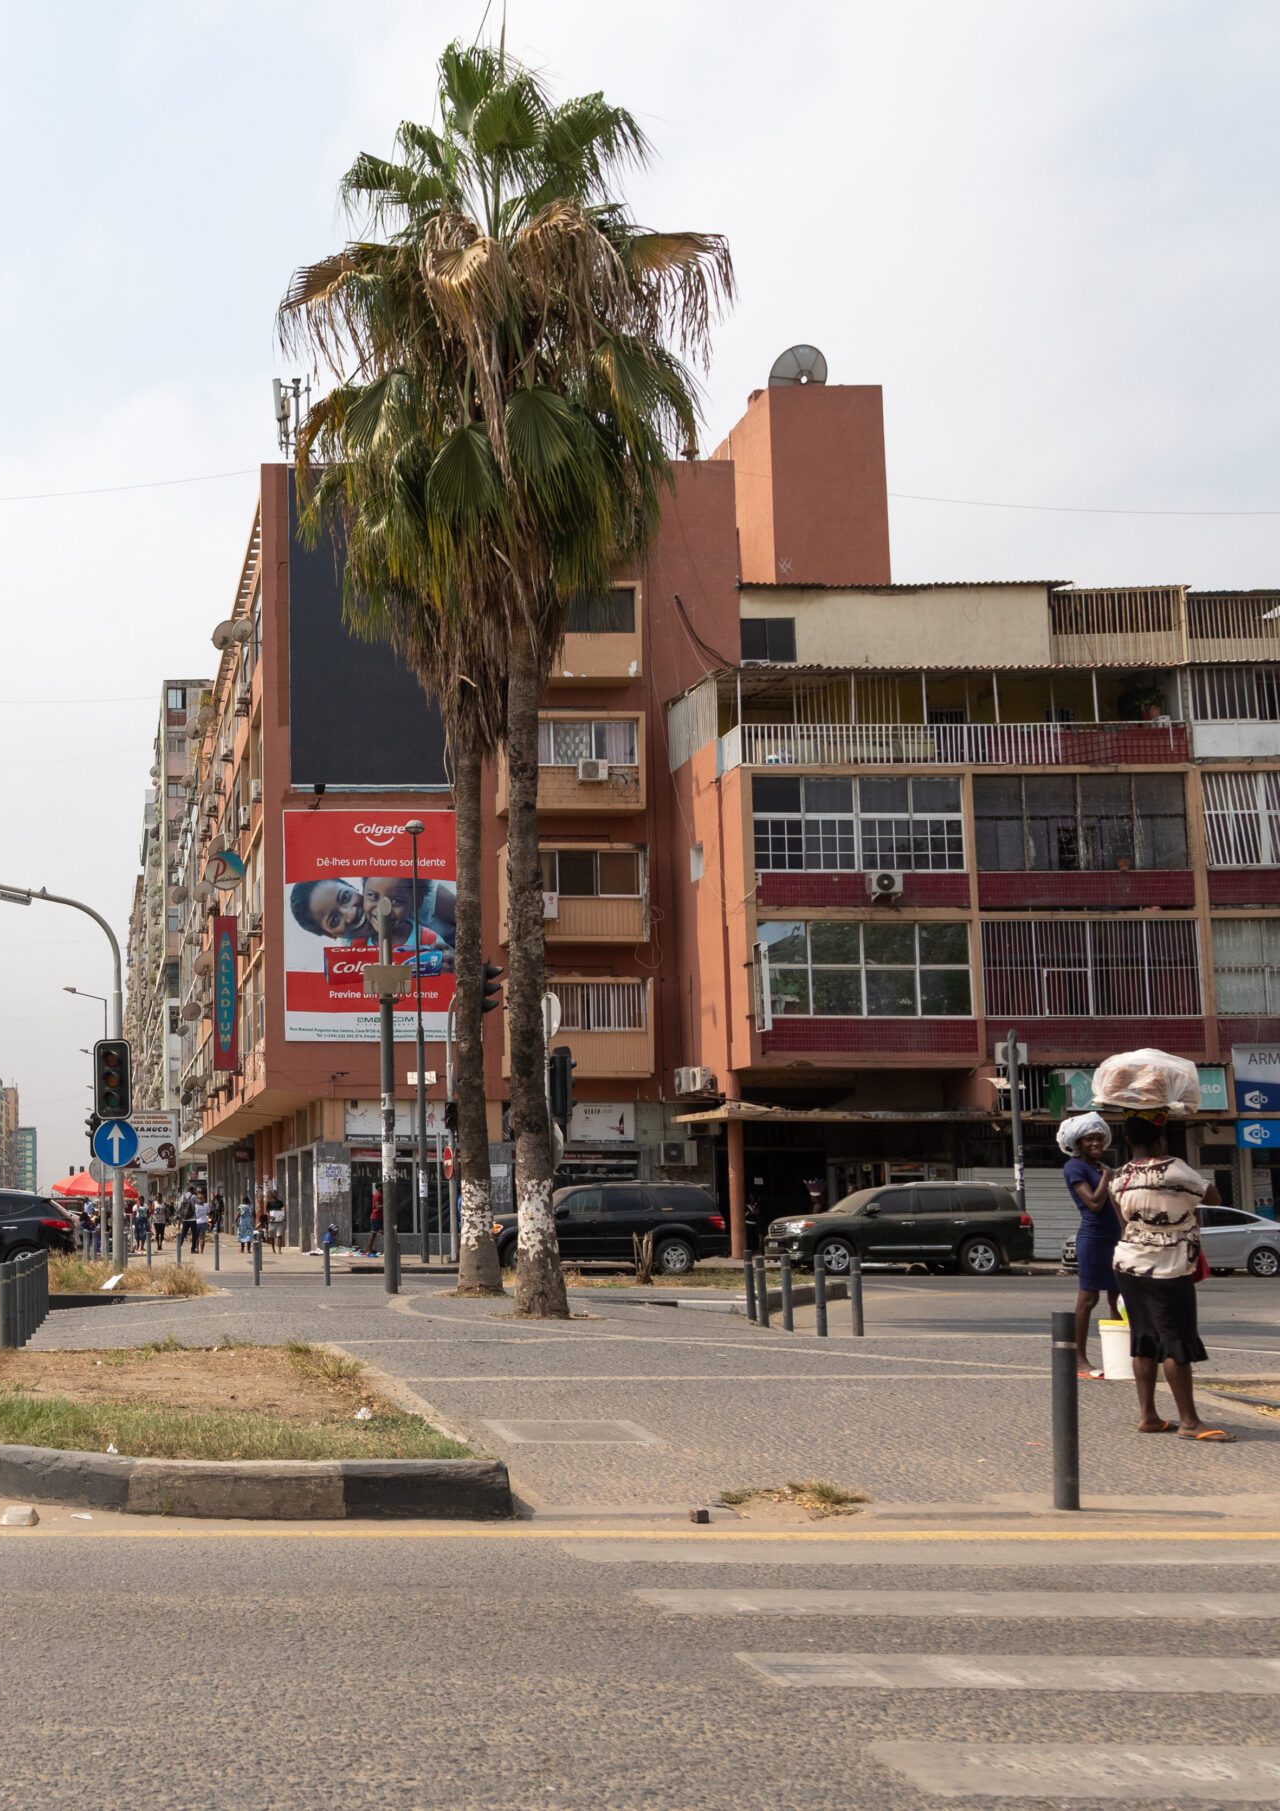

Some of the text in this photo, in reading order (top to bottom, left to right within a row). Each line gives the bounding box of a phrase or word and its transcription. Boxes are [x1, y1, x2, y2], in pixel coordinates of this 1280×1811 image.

[353, 823, 406, 837] Colgate
[316, 857, 446, 867] Dê-lhes um futuro soridente
[220, 940, 232, 1042] PALLADIUM
[329, 990, 361, 999] Previne
